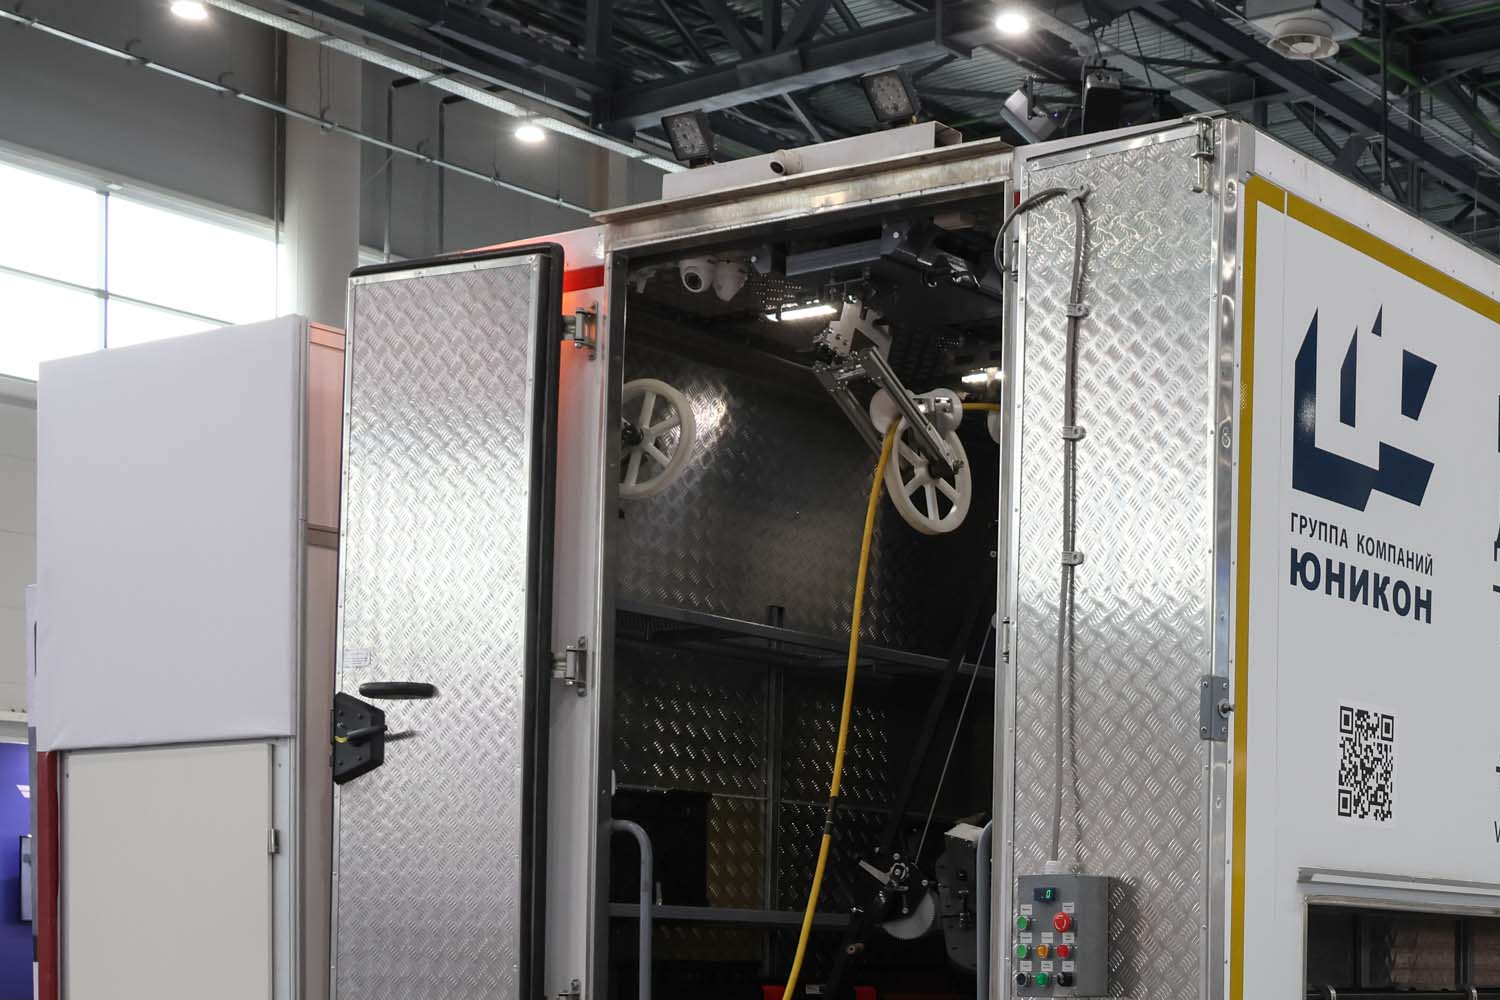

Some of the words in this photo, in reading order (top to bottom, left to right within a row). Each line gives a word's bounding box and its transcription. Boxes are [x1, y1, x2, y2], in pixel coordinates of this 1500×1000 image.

[1290, 512, 1349, 549] ГРУППА
[1357, 533, 1434, 577] КОМПАНИЙ
[1289, 546, 1433, 625] ЮНИКОН
